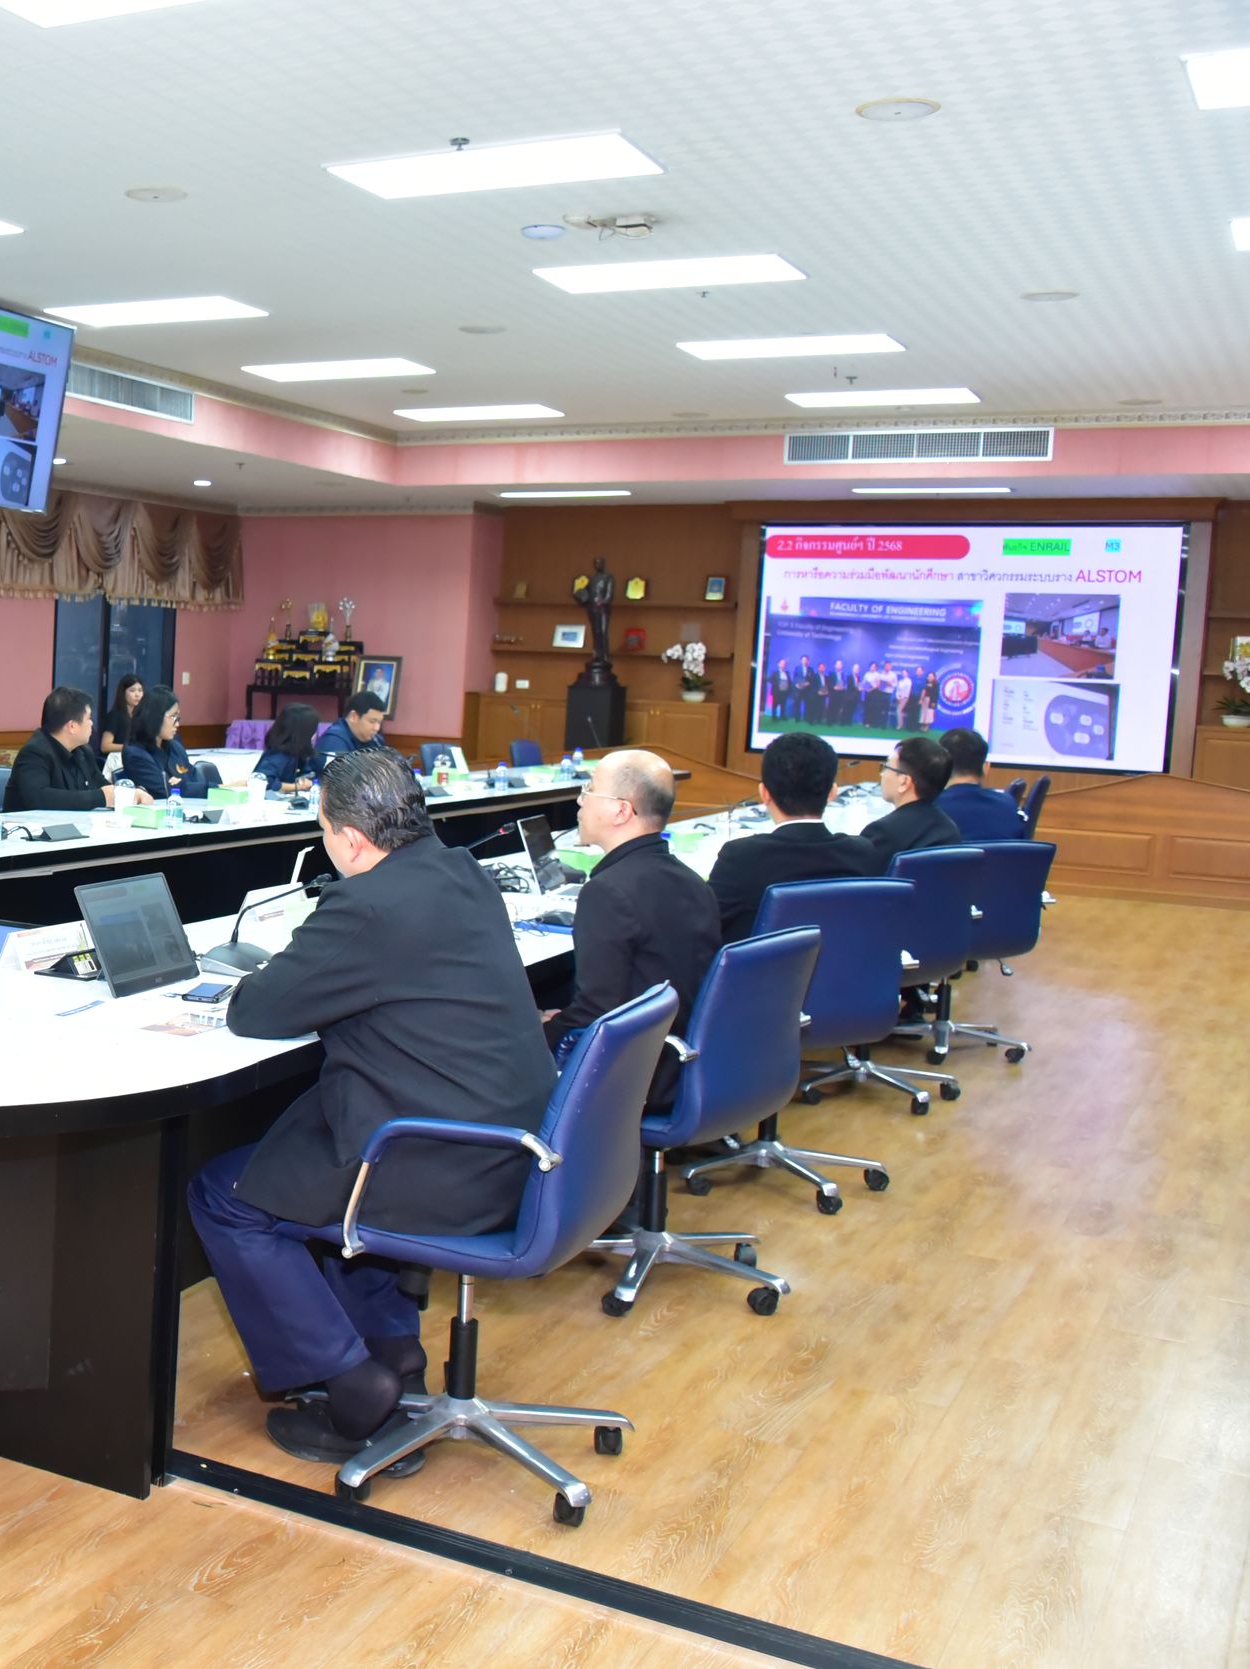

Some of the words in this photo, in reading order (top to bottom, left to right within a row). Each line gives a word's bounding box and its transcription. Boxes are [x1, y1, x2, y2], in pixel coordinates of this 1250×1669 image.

[777, 540, 793, 551] 2.2
[867, 537, 876, 551] ปี
[877, 540, 903, 552] 2568
[1030, 542, 1070, 553] ENRAIL
[1105, 542, 1121, 553] M3
[1075, 569, 1142, 583] ALSTOM
[830, 602, 868, 613] FACULTY
[871, 605, 883, 614] OF
[885, 606, 947, 618] ENGINEERING
